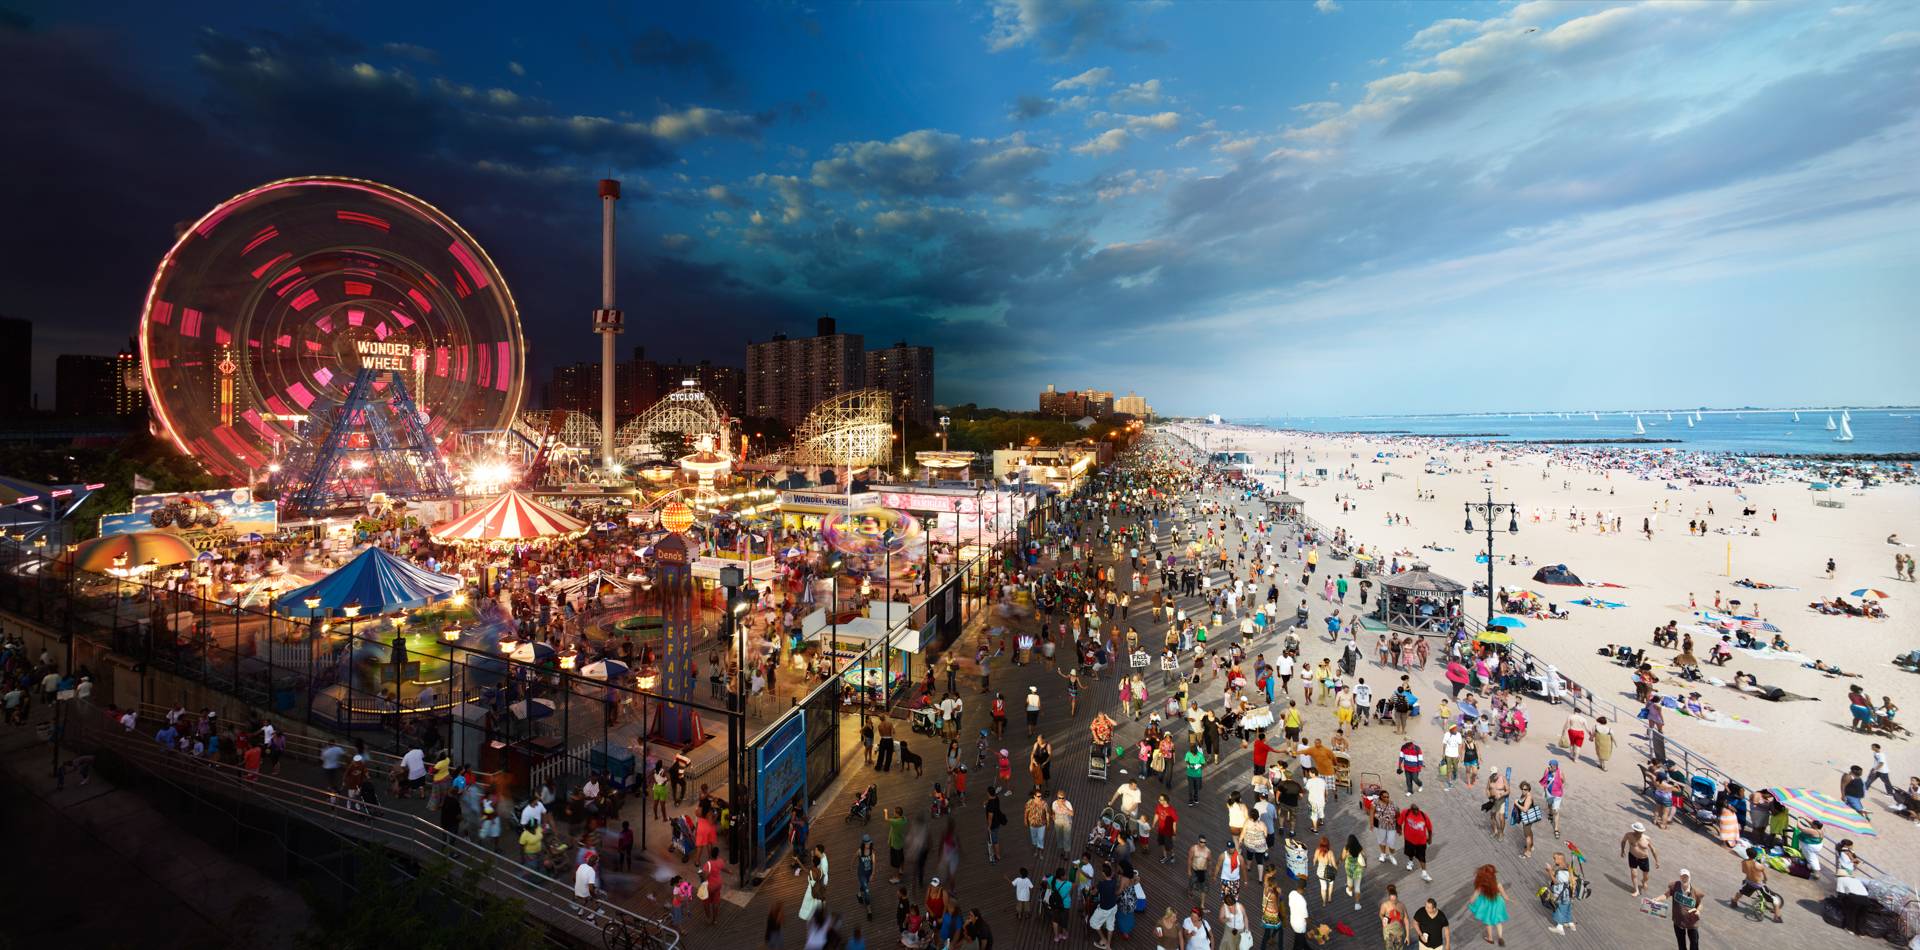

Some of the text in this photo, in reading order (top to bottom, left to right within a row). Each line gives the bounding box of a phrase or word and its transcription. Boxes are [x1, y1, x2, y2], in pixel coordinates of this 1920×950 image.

[357, 341, 410, 356] WONDER
[362, 356, 407, 371] WHEEL
[670, 392, 705, 401] CYCLONE
[793, 494, 824, 504] WONDER
[658, 549, 682, 561] Deno's
